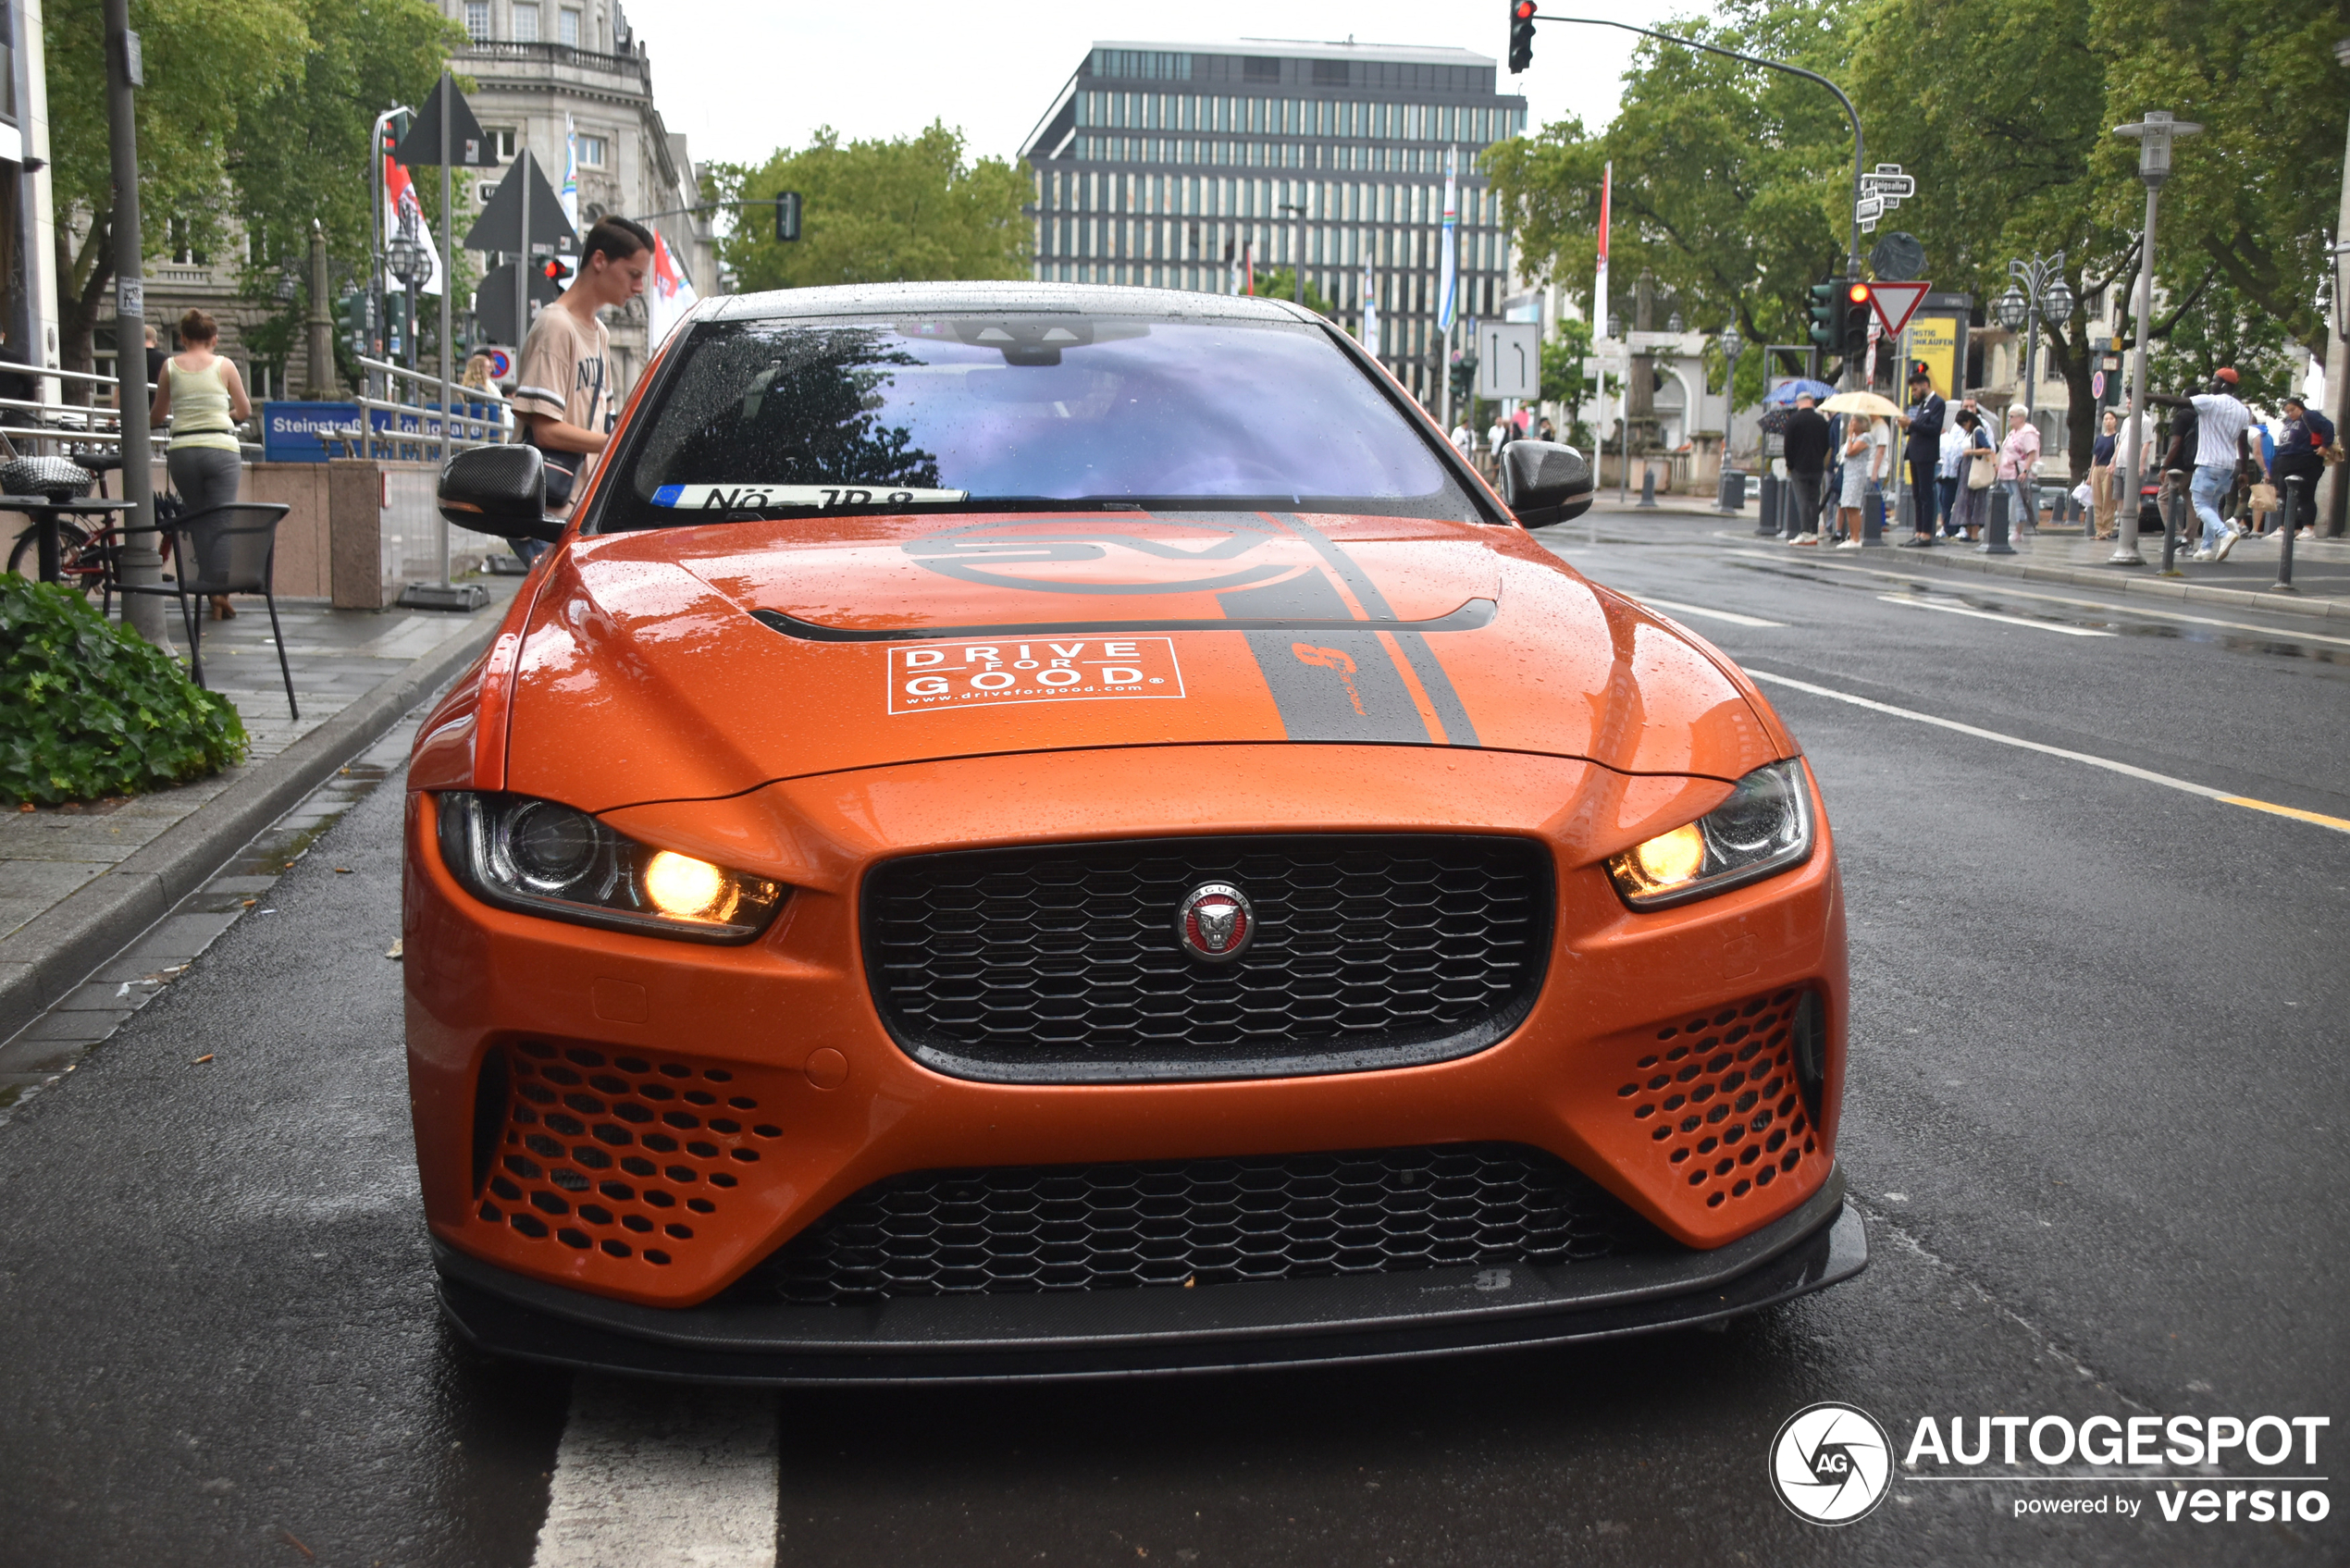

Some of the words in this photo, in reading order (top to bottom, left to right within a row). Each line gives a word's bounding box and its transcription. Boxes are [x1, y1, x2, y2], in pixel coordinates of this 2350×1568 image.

[907, 642, 1141, 667] DRIVE
[985, 658, 1072, 672] FOR
[907, 685, 1143, 704] www.driveforgood.com
[1186, 886, 1249, 910] JAGUAR
